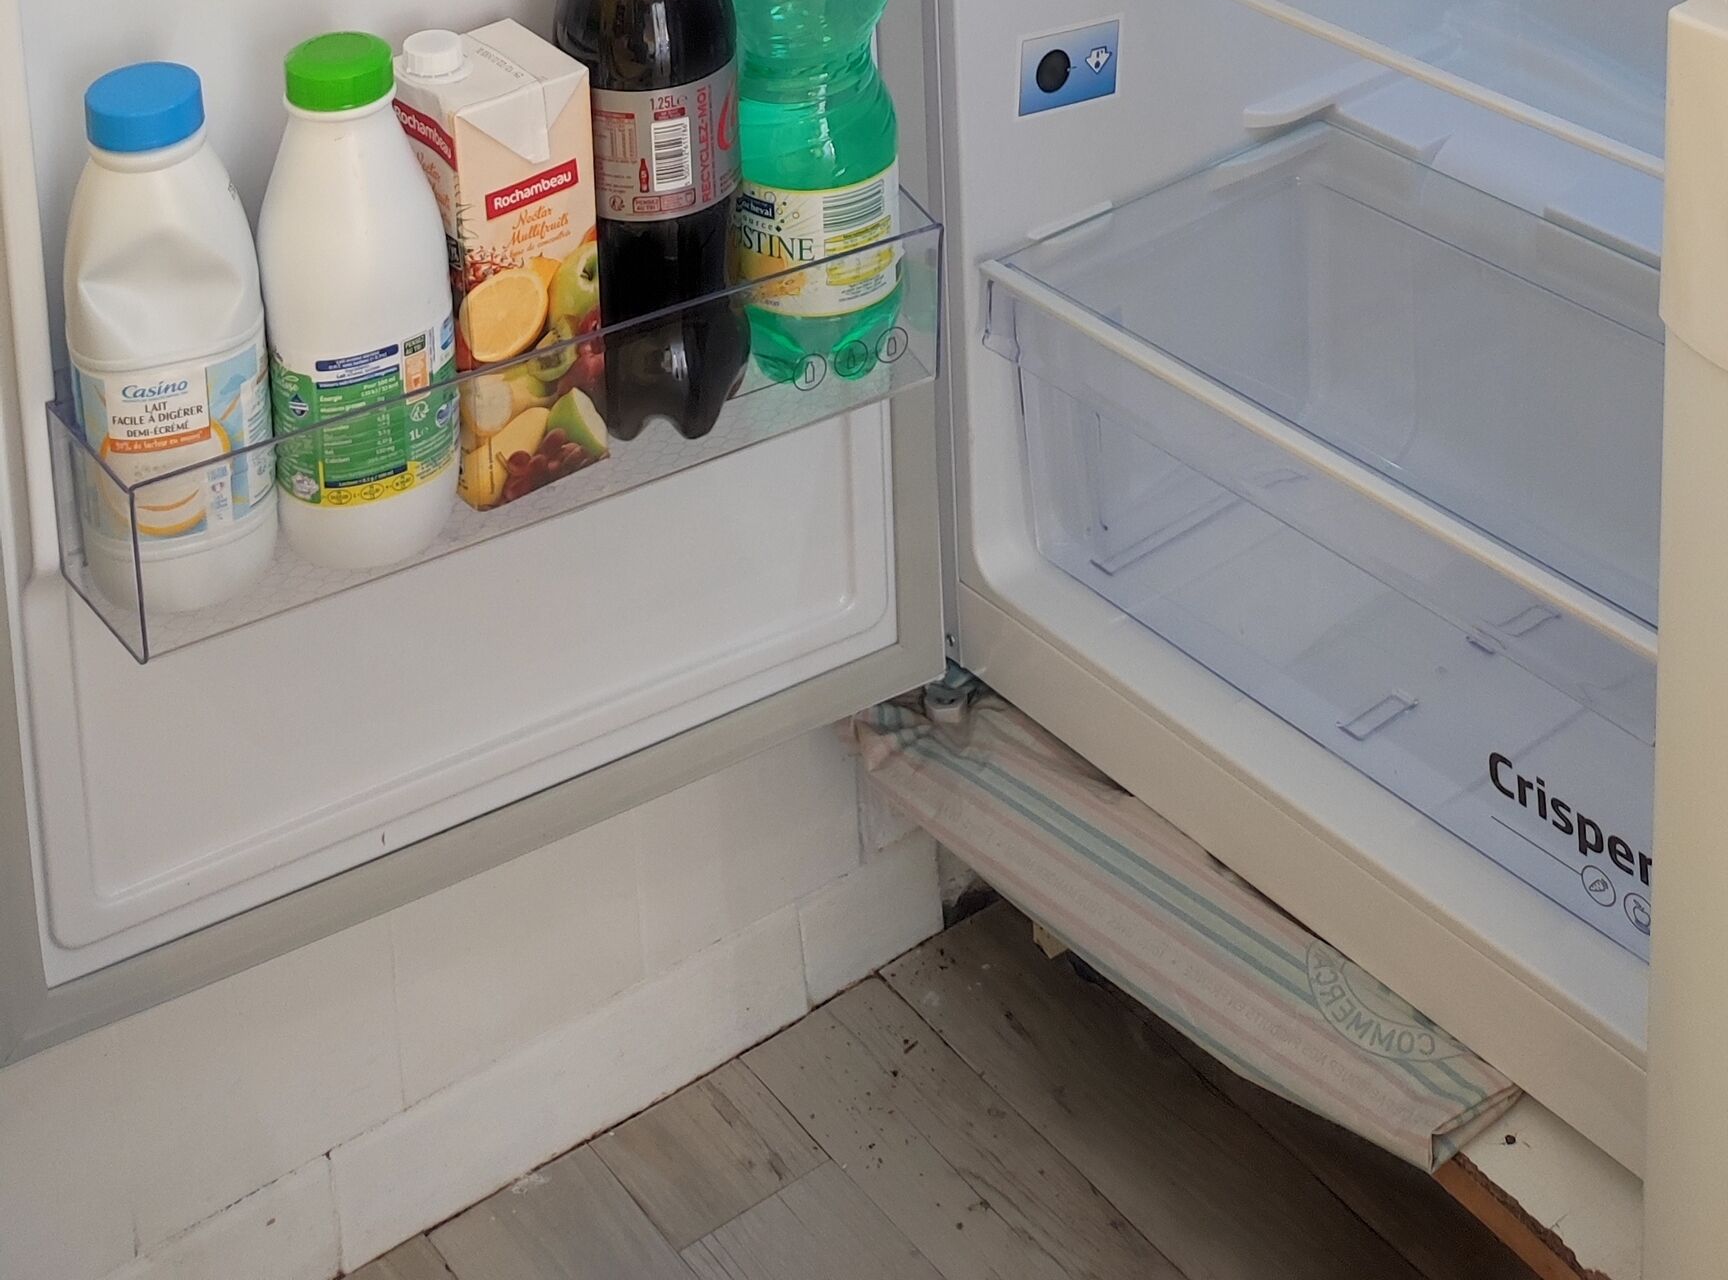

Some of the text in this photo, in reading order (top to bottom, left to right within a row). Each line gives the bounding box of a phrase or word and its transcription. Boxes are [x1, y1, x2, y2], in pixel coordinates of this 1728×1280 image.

[493, 170, 572, 210] Rochambeau
[121, 379, 188, 399] Casino
[112, 405, 204, 425] FACILE À DIGÉRER
[144, 401, 168, 413] LAIT
[126, 420, 190, 438] DEMI-ÉCRÉMÉ
[1488, 752, 1653, 886] Crisper
